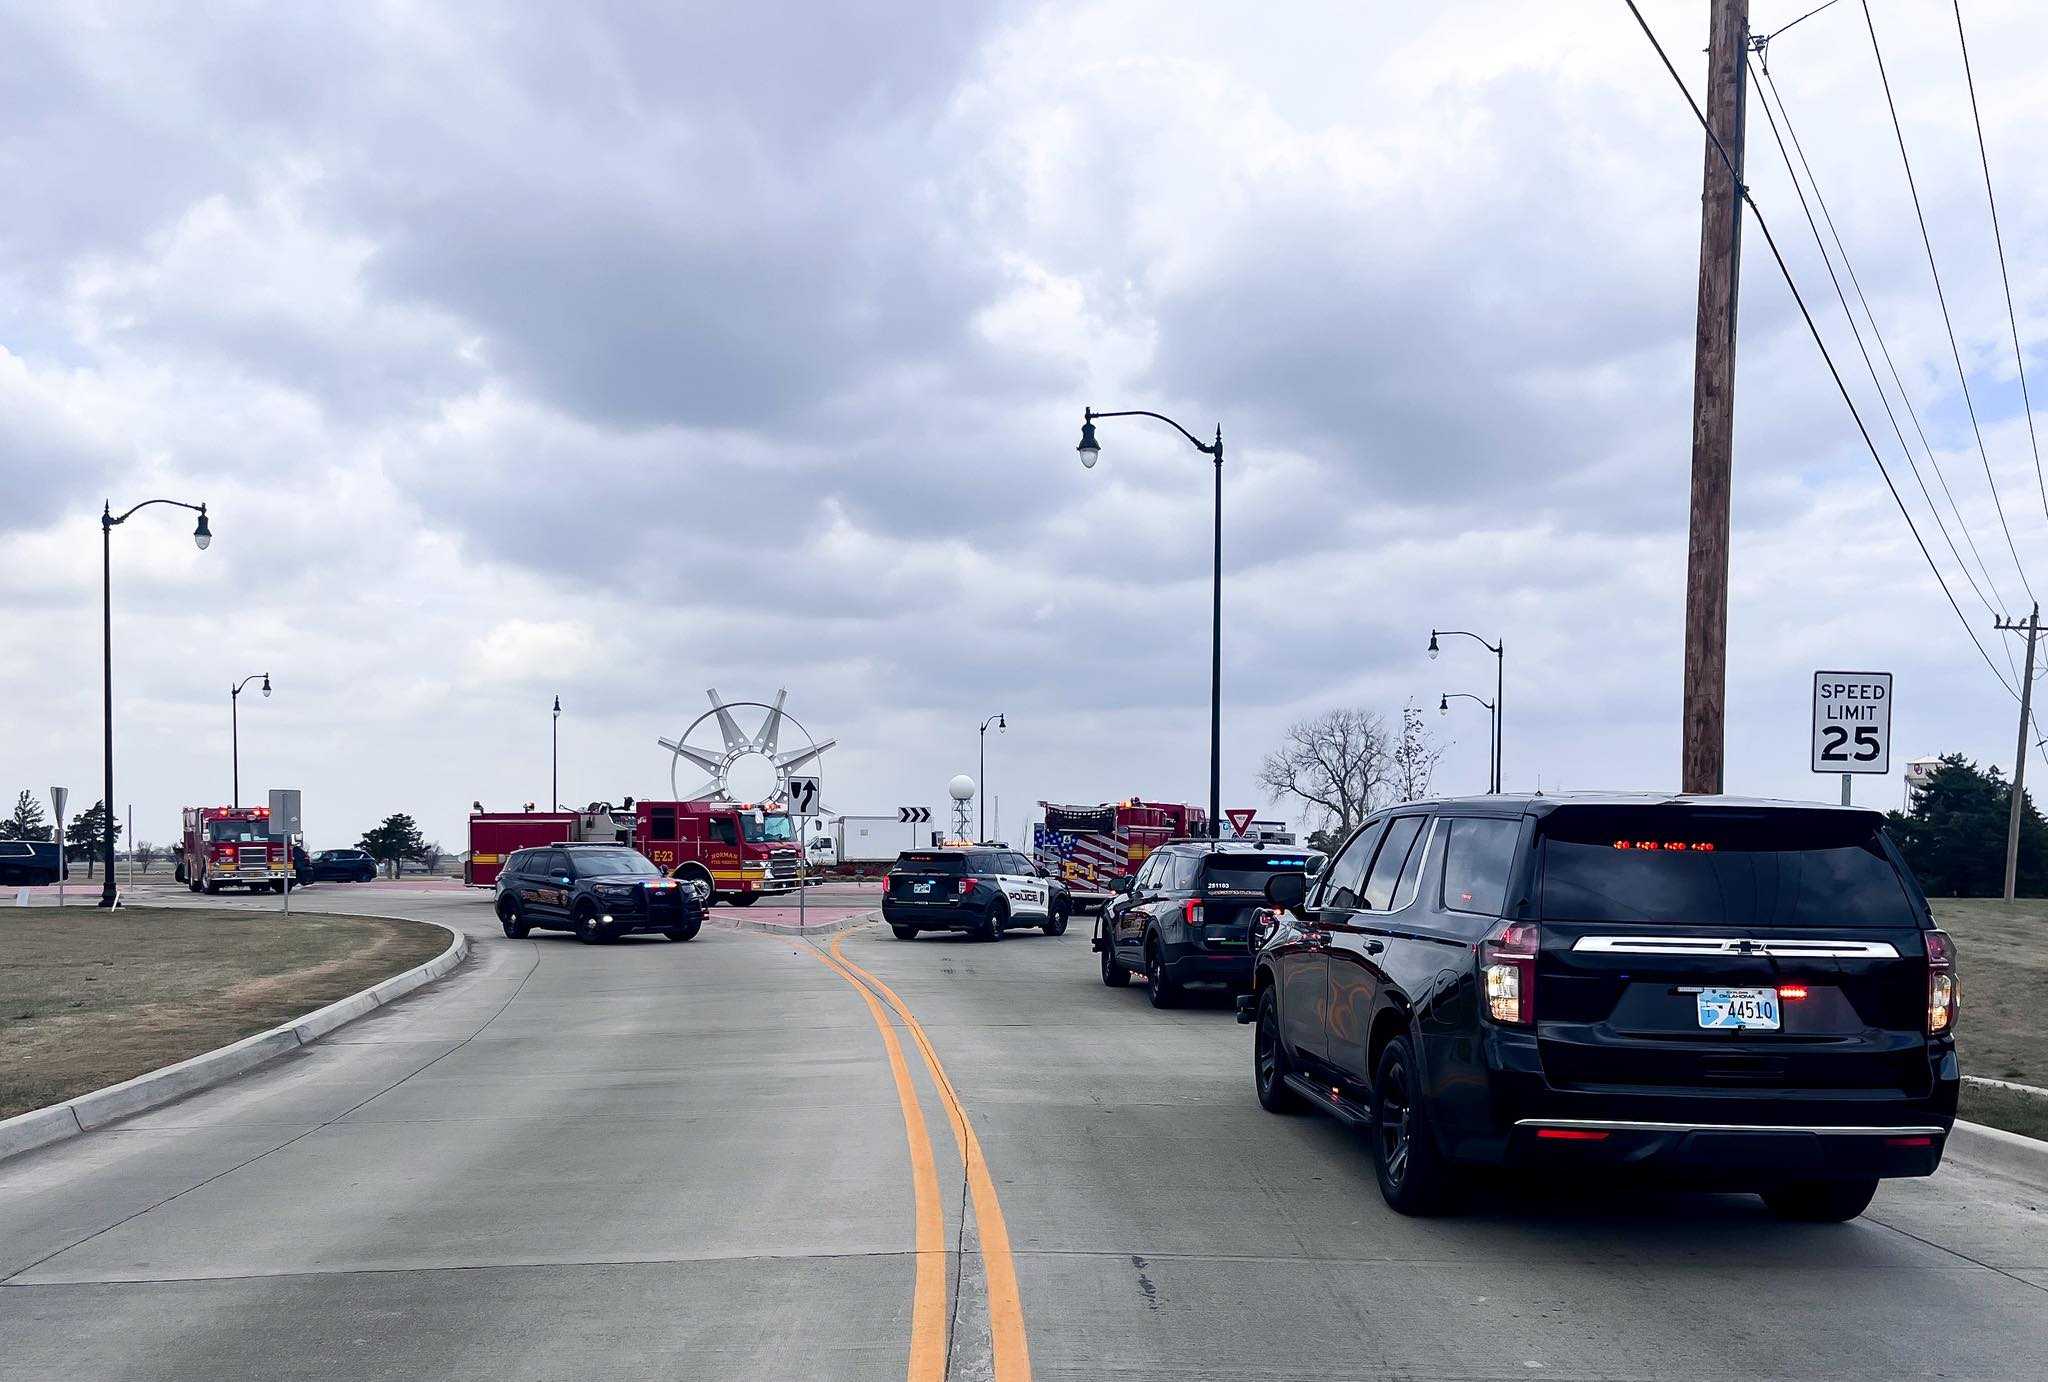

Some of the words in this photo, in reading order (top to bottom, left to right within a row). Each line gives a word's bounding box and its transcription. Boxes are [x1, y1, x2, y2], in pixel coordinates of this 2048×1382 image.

[1821, 684, 1885, 700] SPEED
[1828, 705, 1877, 720] LIMIT
[1821, 726, 1880, 761] 25
[654, 850, 673, 862] E-23
[1065, 862, 1095, 880] E-1
[1009, 892, 1038, 902] POLICE
[1728, 1001, 1773, 1019] 44510
